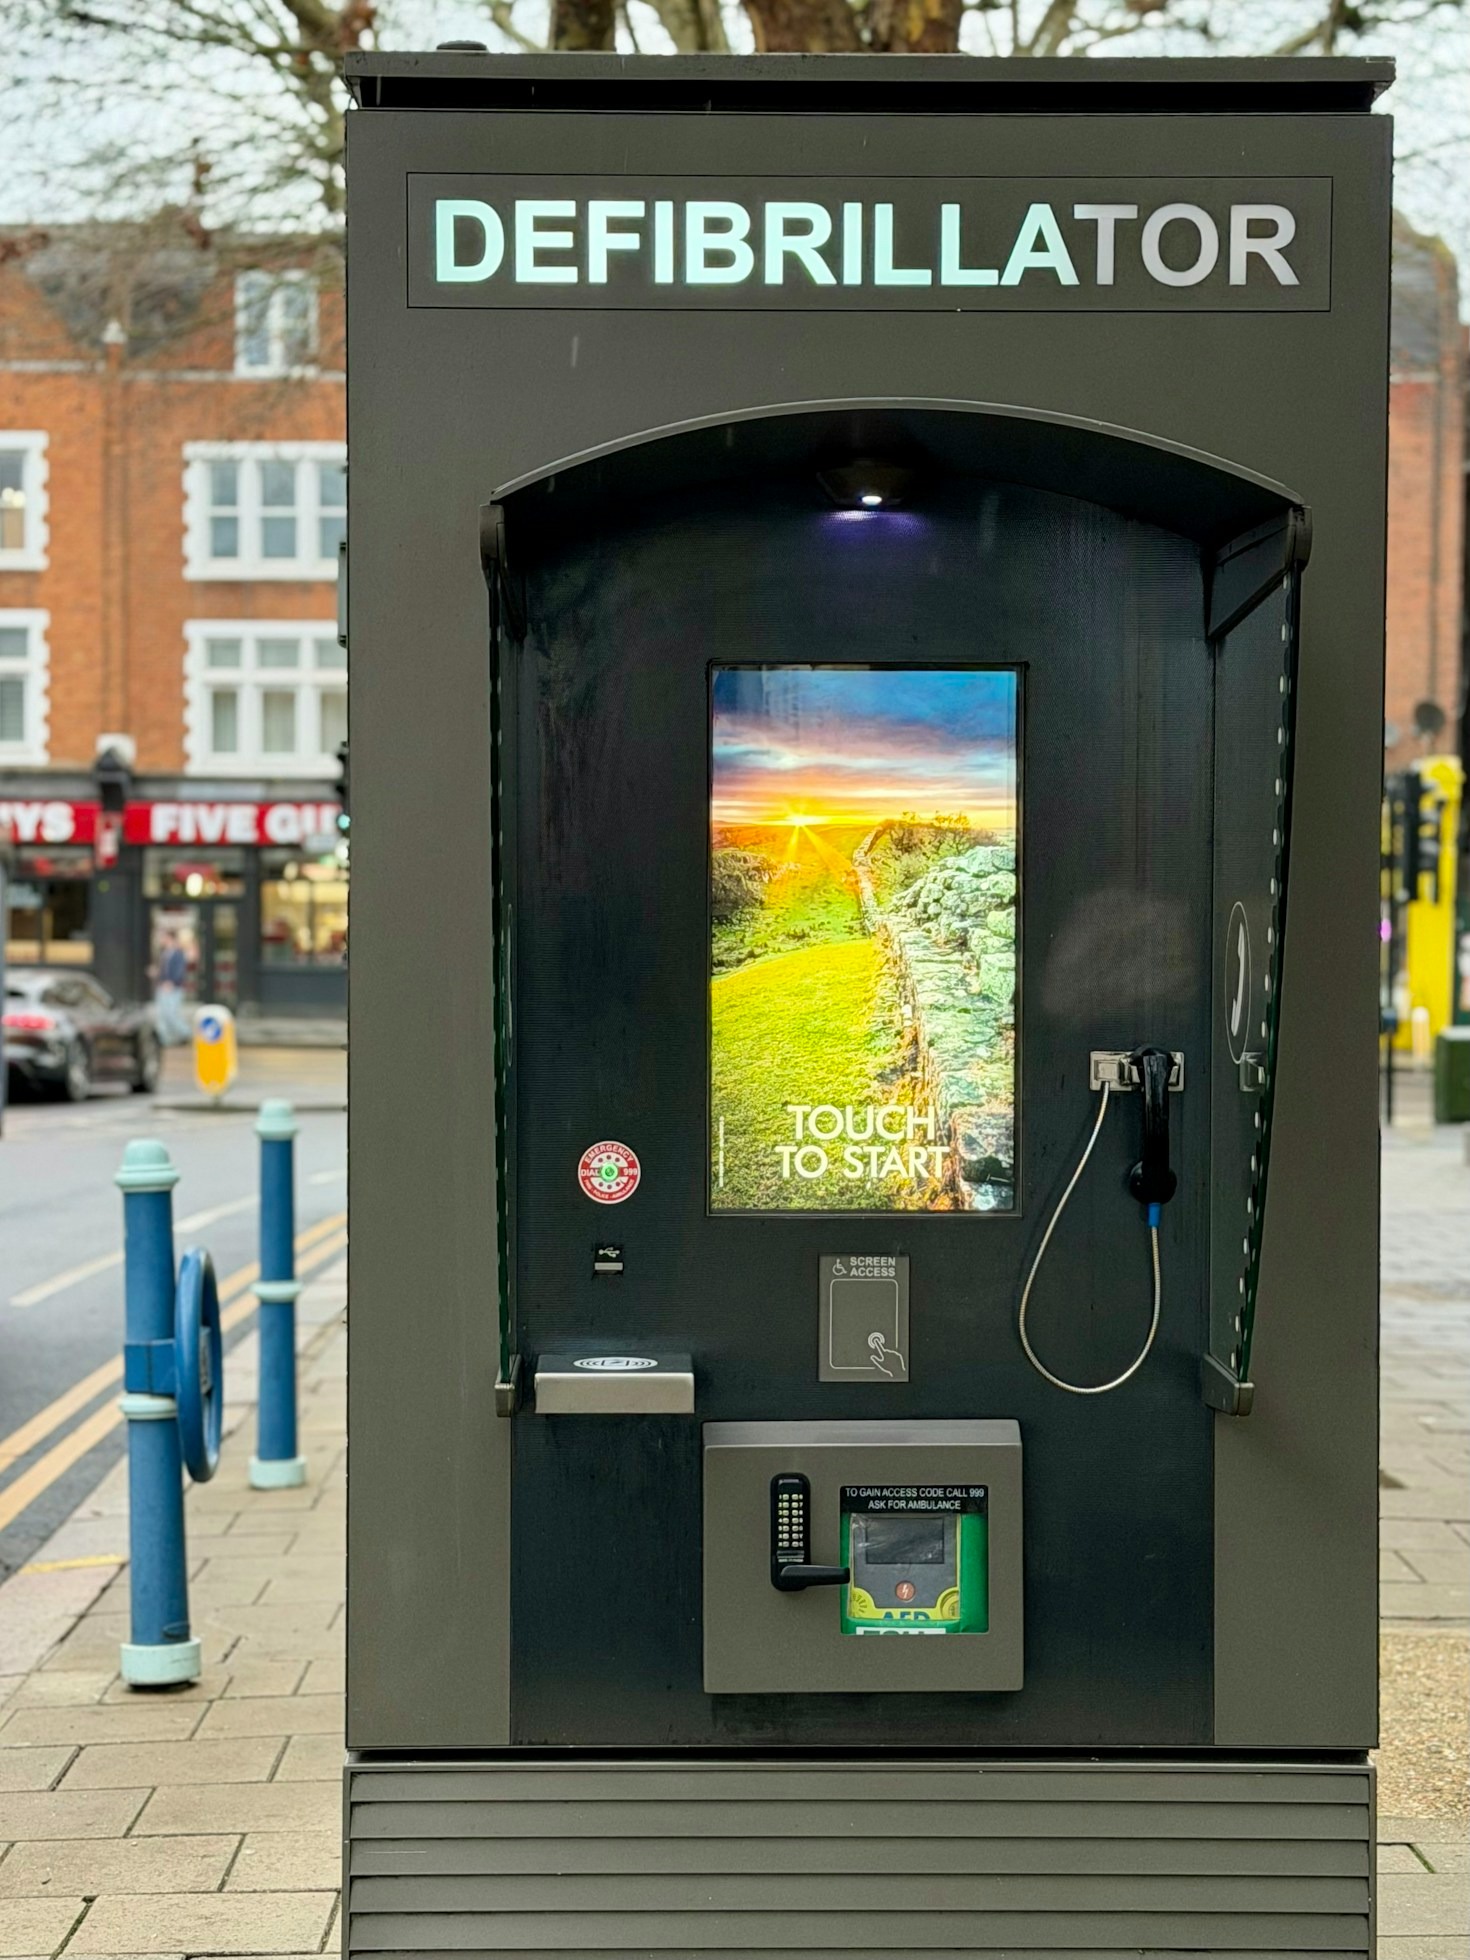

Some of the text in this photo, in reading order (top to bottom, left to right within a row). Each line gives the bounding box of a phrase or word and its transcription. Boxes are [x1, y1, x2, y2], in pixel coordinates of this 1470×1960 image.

[434, 198, 1300, 288] DEFIBRILLATOR
[0, 802, 75, 843] YS
[151, 803, 258, 844] FIVE
[786, 1104, 935, 1141] TOUCH
[584, 1144, 634, 1164] EMERGENCY
[774, 1145, 950, 1179] TO START
[581, 1168, 638, 1177] DIAL 999
[849, 1256, 896, 1266] SCREEN
[849, 1267, 896, 1277] ACCESS
[845, 1488, 985, 1497] TO GAIN ACCESS CODE CALL 999
[868, 1500, 961, 1509] ASK FOR AMBULANCE
